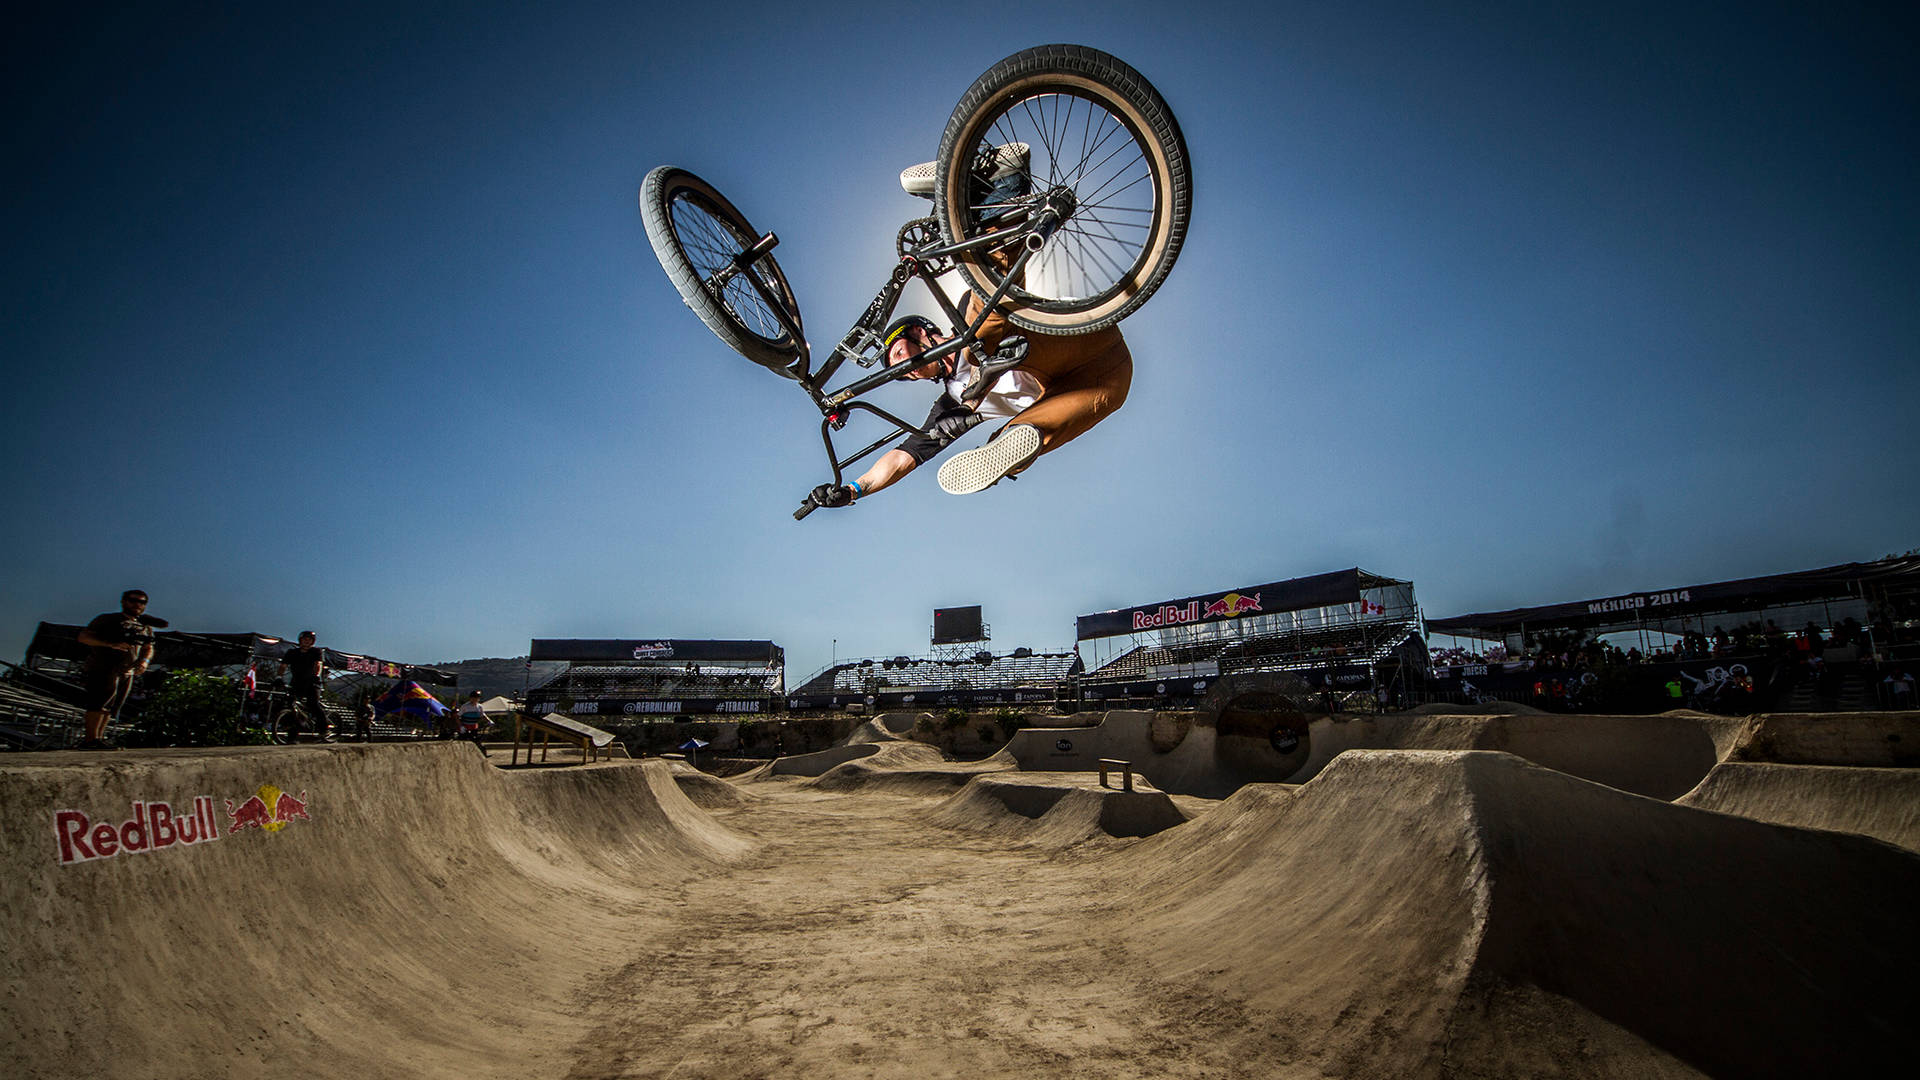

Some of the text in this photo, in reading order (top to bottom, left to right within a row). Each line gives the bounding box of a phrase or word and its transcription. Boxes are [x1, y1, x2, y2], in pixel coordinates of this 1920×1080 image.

[1588, 590, 1690, 614] MÉXICO 2014
[623, 701, 682, 714] @REDBULLMEX
[715, 701, 760, 713] #TEDAALAS
